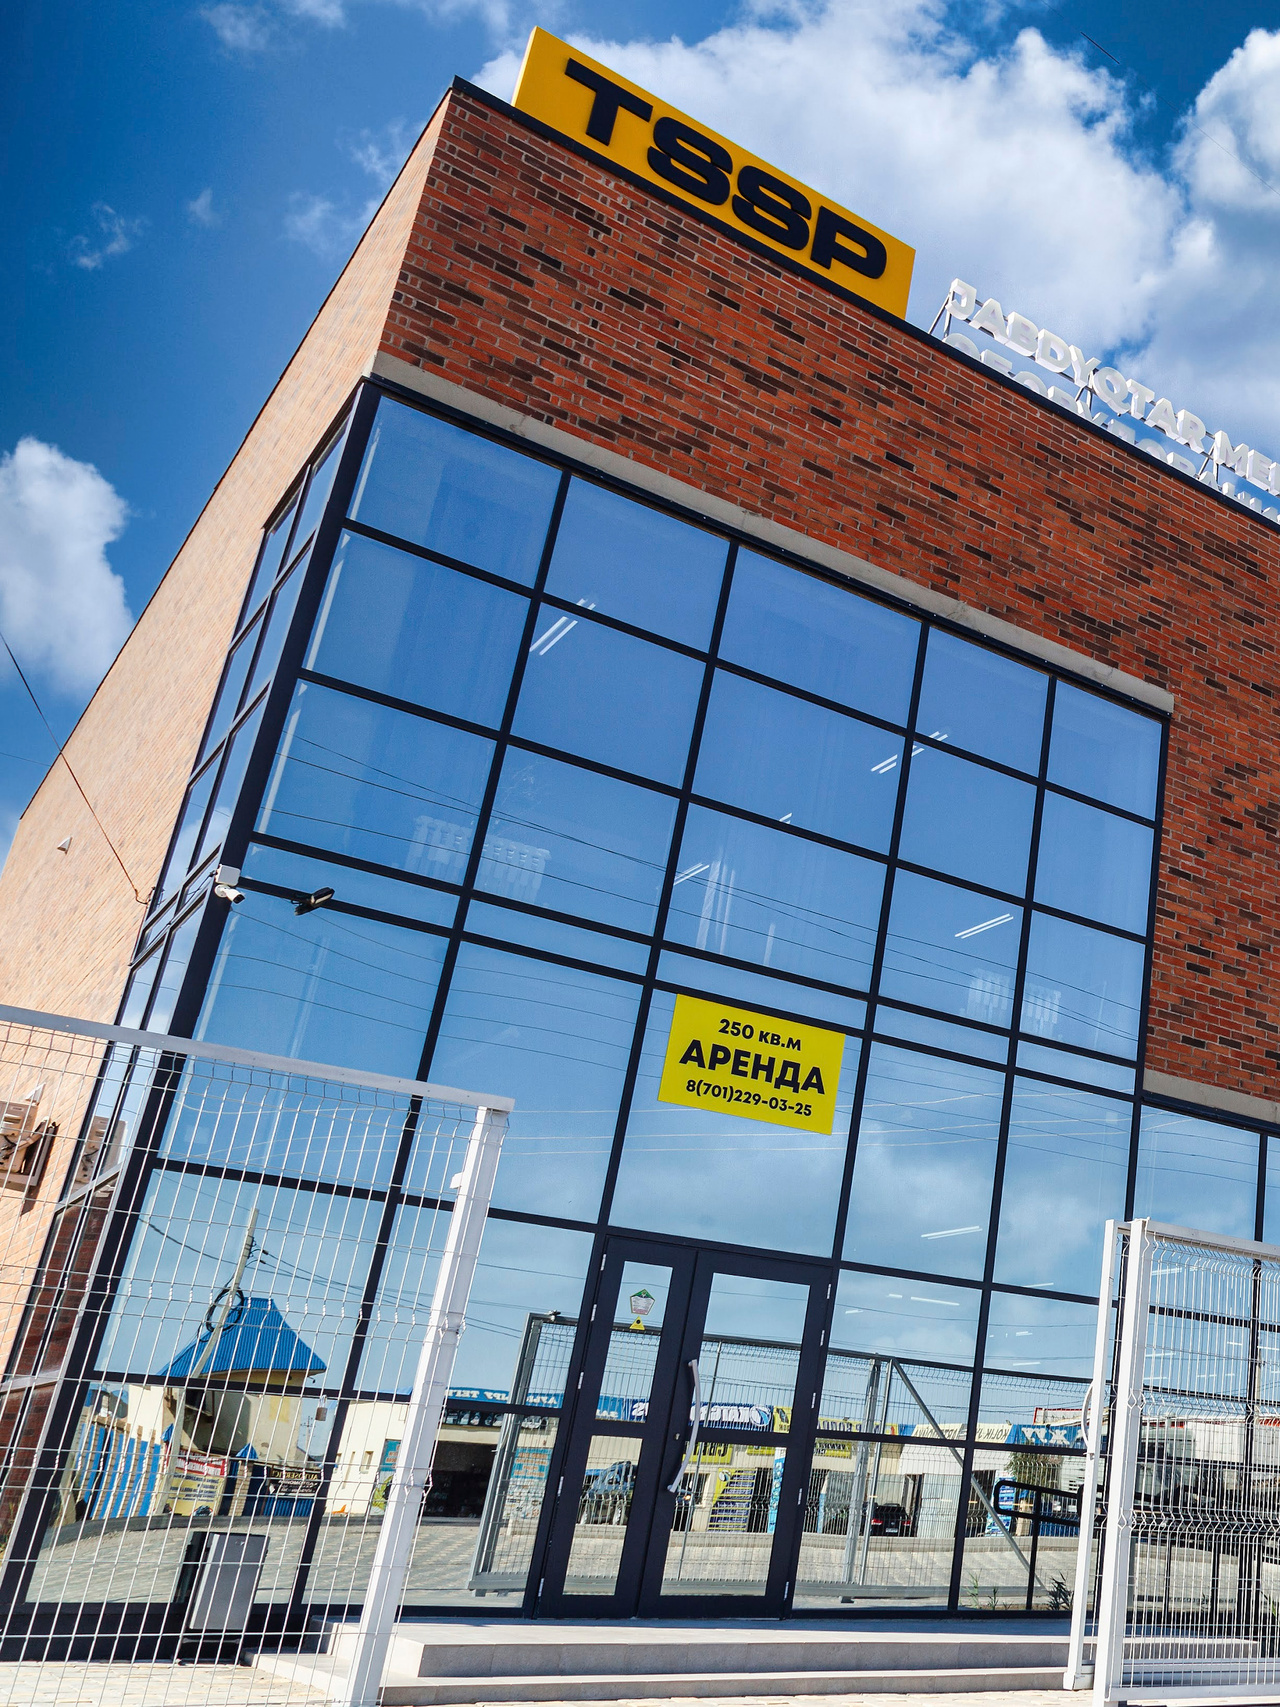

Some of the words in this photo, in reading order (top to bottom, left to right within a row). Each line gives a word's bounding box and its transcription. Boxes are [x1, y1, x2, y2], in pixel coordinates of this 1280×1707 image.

[565, 57, 887, 279] TSSP
[946, 278, 1205, 454] JABDYQTAR
[718, 1018, 754, 1039] 250
[678, 1039, 825, 1095] АРЕНДА
[686, 1079, 812, 1116] 8(701)229-03-25
